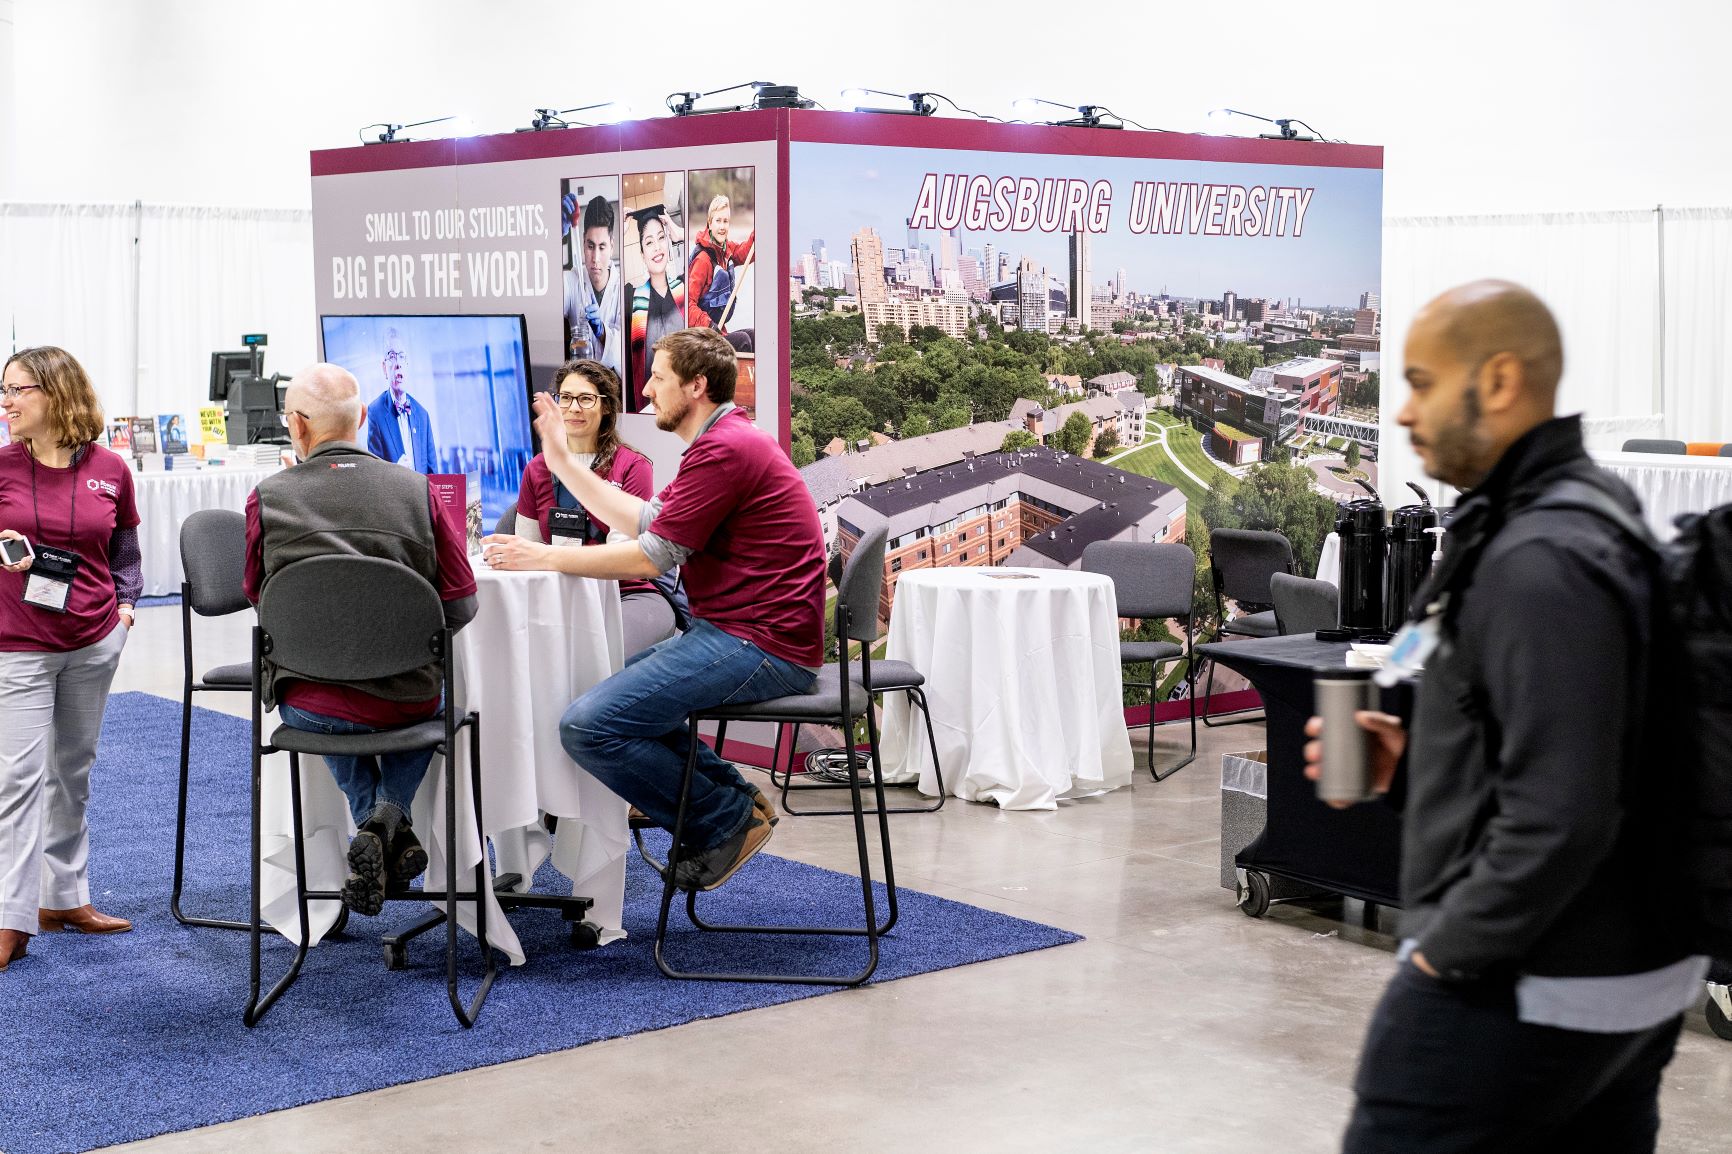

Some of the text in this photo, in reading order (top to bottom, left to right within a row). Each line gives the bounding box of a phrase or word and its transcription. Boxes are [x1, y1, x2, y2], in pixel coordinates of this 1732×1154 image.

[366, 204, 549, 242] SMALL TO OUR STUDENTS,
[910, 173, 1314, 237] AUGSBURG UNIVERSITY
[332, 250, 549, 299] BIG FOR THE WORLD
